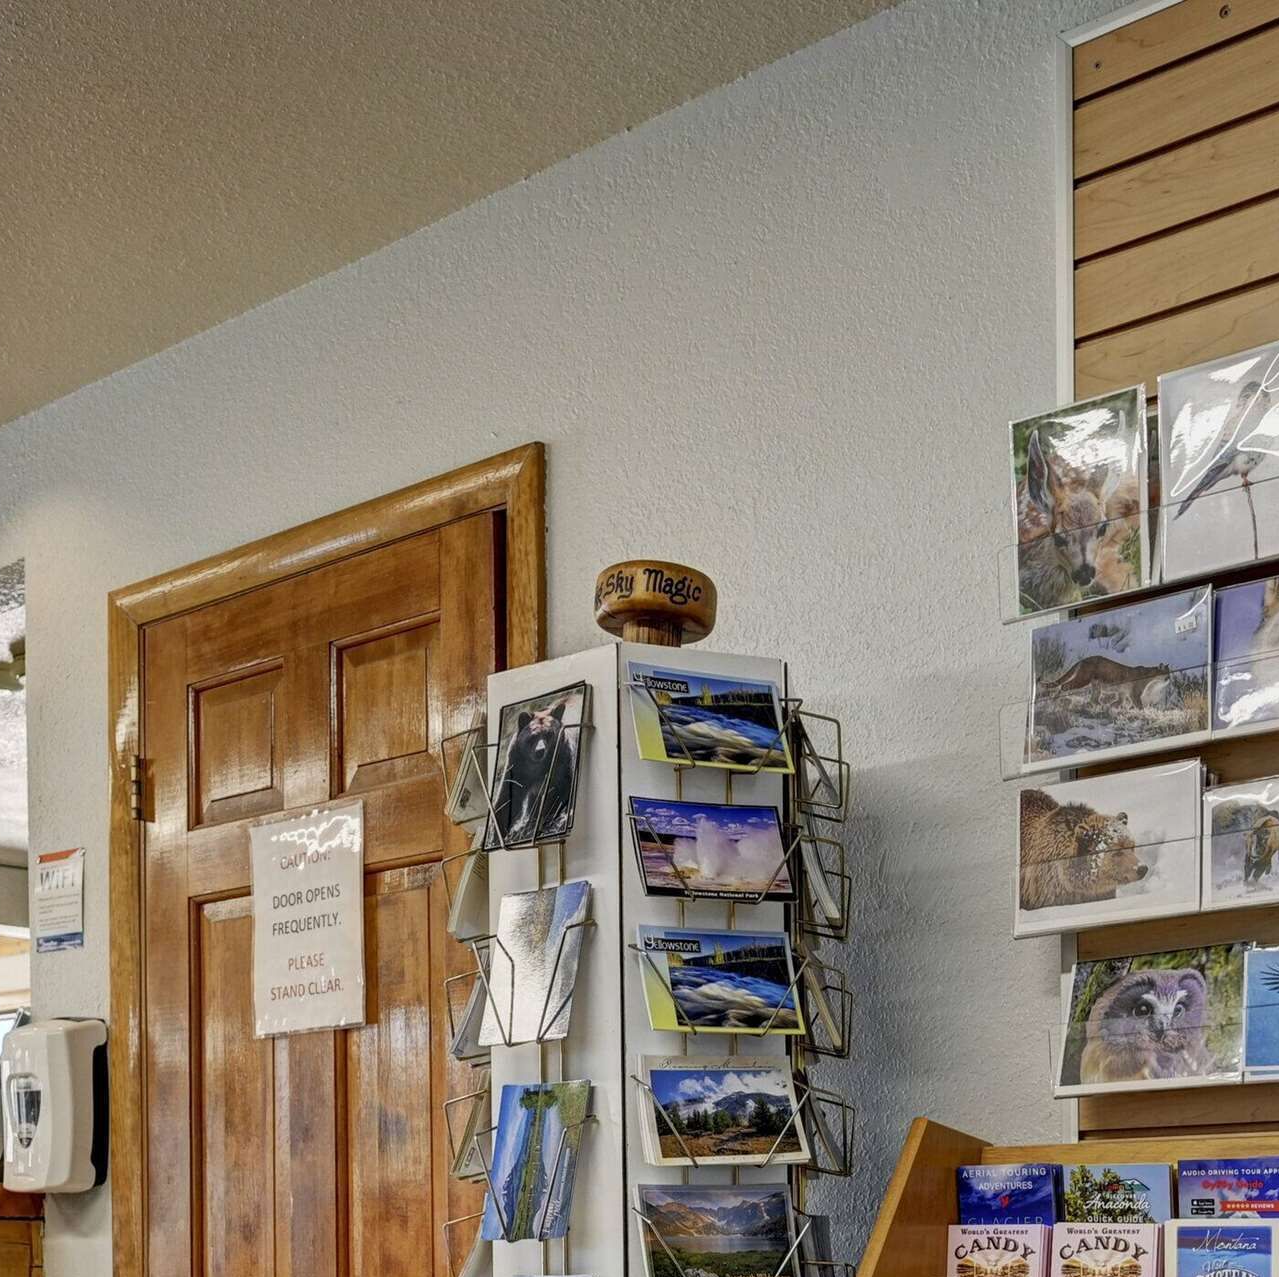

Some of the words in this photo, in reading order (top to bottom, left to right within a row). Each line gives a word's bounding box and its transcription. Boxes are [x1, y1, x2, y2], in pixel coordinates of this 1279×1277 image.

[603, 570, 634, 600] Sky
[643, 568, 702, 605] Magic
[273, 891, 303, 909] DOOR
[306, 883, 341, 903] OPENS
[272, 912, 342, 936] FREQUENTLY.
[288, 953, 325, 971] PLEASE
[271, 984, 306, 1001] STAND
